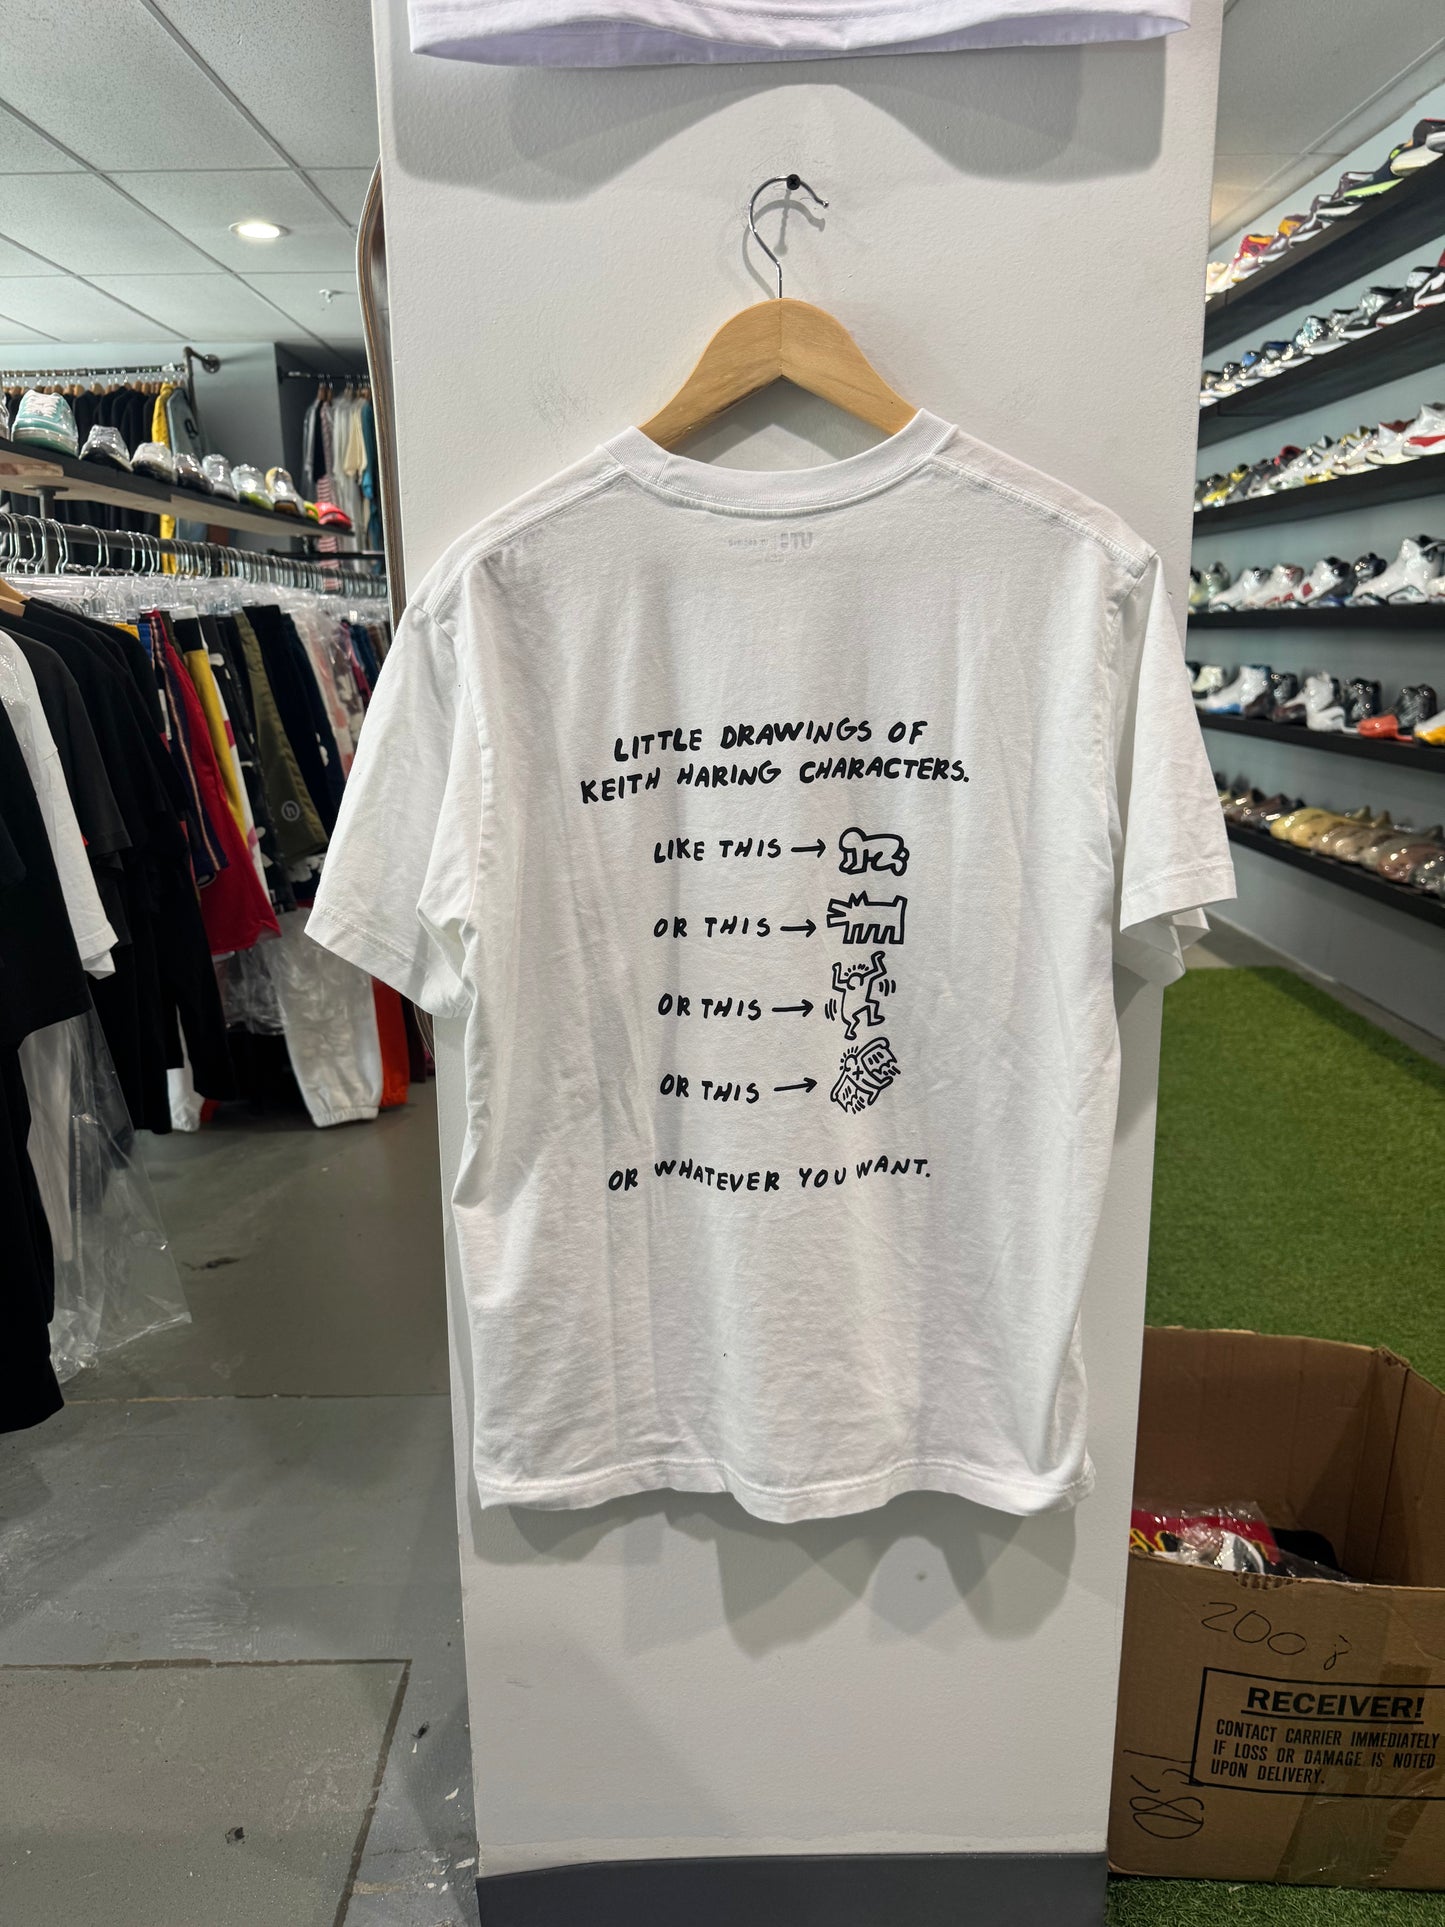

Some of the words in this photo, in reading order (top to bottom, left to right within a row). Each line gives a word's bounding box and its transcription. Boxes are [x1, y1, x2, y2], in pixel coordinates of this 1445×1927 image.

[614, 728, 702, 762] LITTLE
[720, 717, 873, 749] DRAWINGS
[888, 720, 928, 745] OF
[580, 767, 661, 804] KEITH
[677, 760, 781, 788] HARING
[799, 756, 970, 784] CHARACTERS.
[654, 838, 705, 863] LIKE
[719, 838, 781, 858] THIS
[654, 916, 688, 938] OR
[704, 916, 771, 937] THIS
[658, 993, 691, 1017] OR
[701, 998, 762, 1021] THIS
[659, 1074, 690, 1098] OR
[702, 1080, 760, 1104] THIS
[608, 1168, 638, 1191] OR
[655, 1158, 780, 1193] WHATEVER
[799, 1167, 847, 1188] YOU
[856, 1155, 931, 1179] WANT.
[1247, 1687, 1425, 1719] RECEIVER!
[1216, 1719, 1277, 1742] CONTACT
[1285, 1728, 1342, 1746] CARRIER
[1350, 1731, 1440, 1749] IMMEDIATELY
[1213, 1740, 1226, 1755] IF
[1234, 1743, 1268, 1761] LOSS
[1276, 1748, 1295, 1763] OR
[1304, 1750, 1362, 1767] DAMAGE
[1371, 1752, 1385, 1768] IS
[1393, 1753, 1436, 1769] NOTED
[1211, 1759, 1248, 1778] UPON
[1257, 1765, 1325, 1784] DELIVERY.
